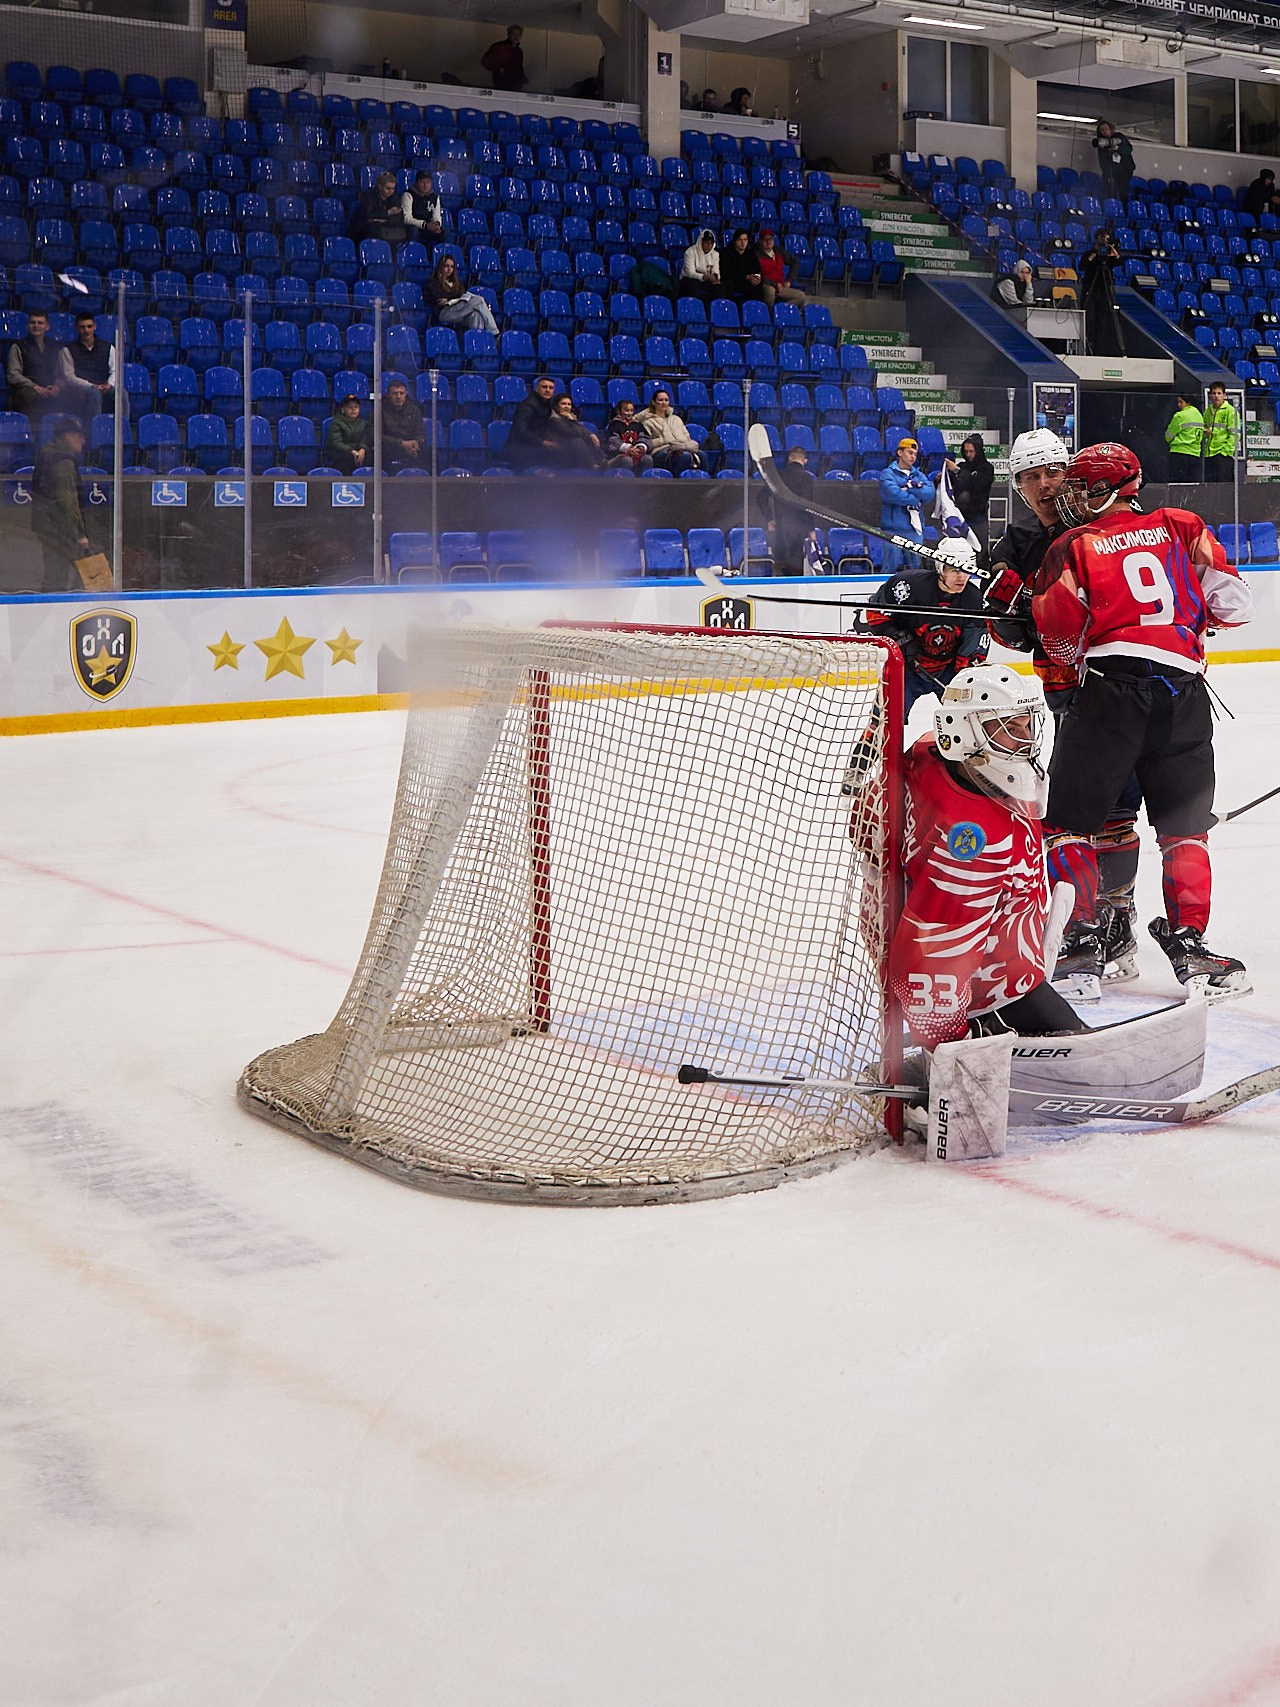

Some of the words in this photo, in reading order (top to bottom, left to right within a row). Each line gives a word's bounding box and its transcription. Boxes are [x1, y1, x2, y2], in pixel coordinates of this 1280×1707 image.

[213, 10, 237, 21] AREA
[1189, 2, 1260, 24] ЧЕМПИОНАТ
[660, 56, 669, 69] 1
[788, 124, 799, 137] 5
[881, 212, 912, 222] SYNERGETIC
[902, 238, 934, 247] SYNERGETIC
[923, 260, 956, 269] SYNERGETIC
[851, 334, 864, 342] ДЛЯ
[865, 335, 893, 343] ЧИСТОТЫ
[871, 349, 906, 358] SYNERGETIC
[874, 361, 887, 369] ДЛЯ
[888, 362, 915, 370] КРАСОТЫ
[895, 376, 930, 386] SYNERGETIC
[909, 391, 941, 399] ЗДОРОВЬЯ
[921, 404, 956, 413] SYNERGETIC
[927, 418, 940, 426] ДЛЯ
[941, 418, 969, 426] ЧИСТОТЫ
[1092, 526, 1173, 556] МАКСИМОВИЧ
[1122, 552, 1175, 626] 9
[907, 973, 959, 1015] 33
[1012, 1047, 1072, 1058] UER
[1032, 1099, 1171, 1119] BAUER
[936, 1097, 949, 1160] BAUER
